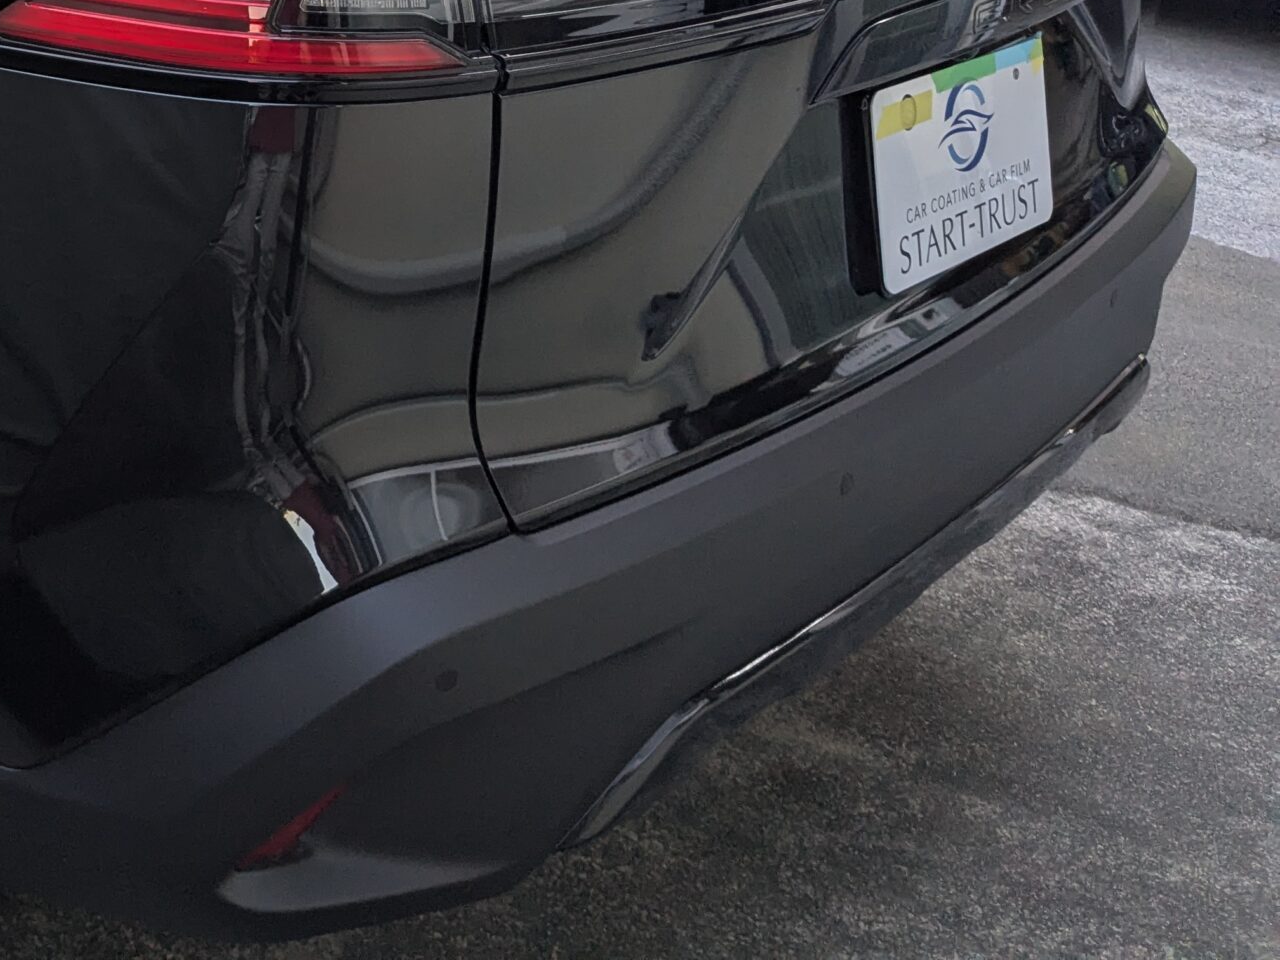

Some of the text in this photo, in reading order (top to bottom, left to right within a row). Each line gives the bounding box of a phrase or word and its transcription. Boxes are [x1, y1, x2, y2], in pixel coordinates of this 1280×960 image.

[899, 178, 1039, 275] START-TRUST
[906, 158, 1031, 224] CAR COATING & CAR FILM
